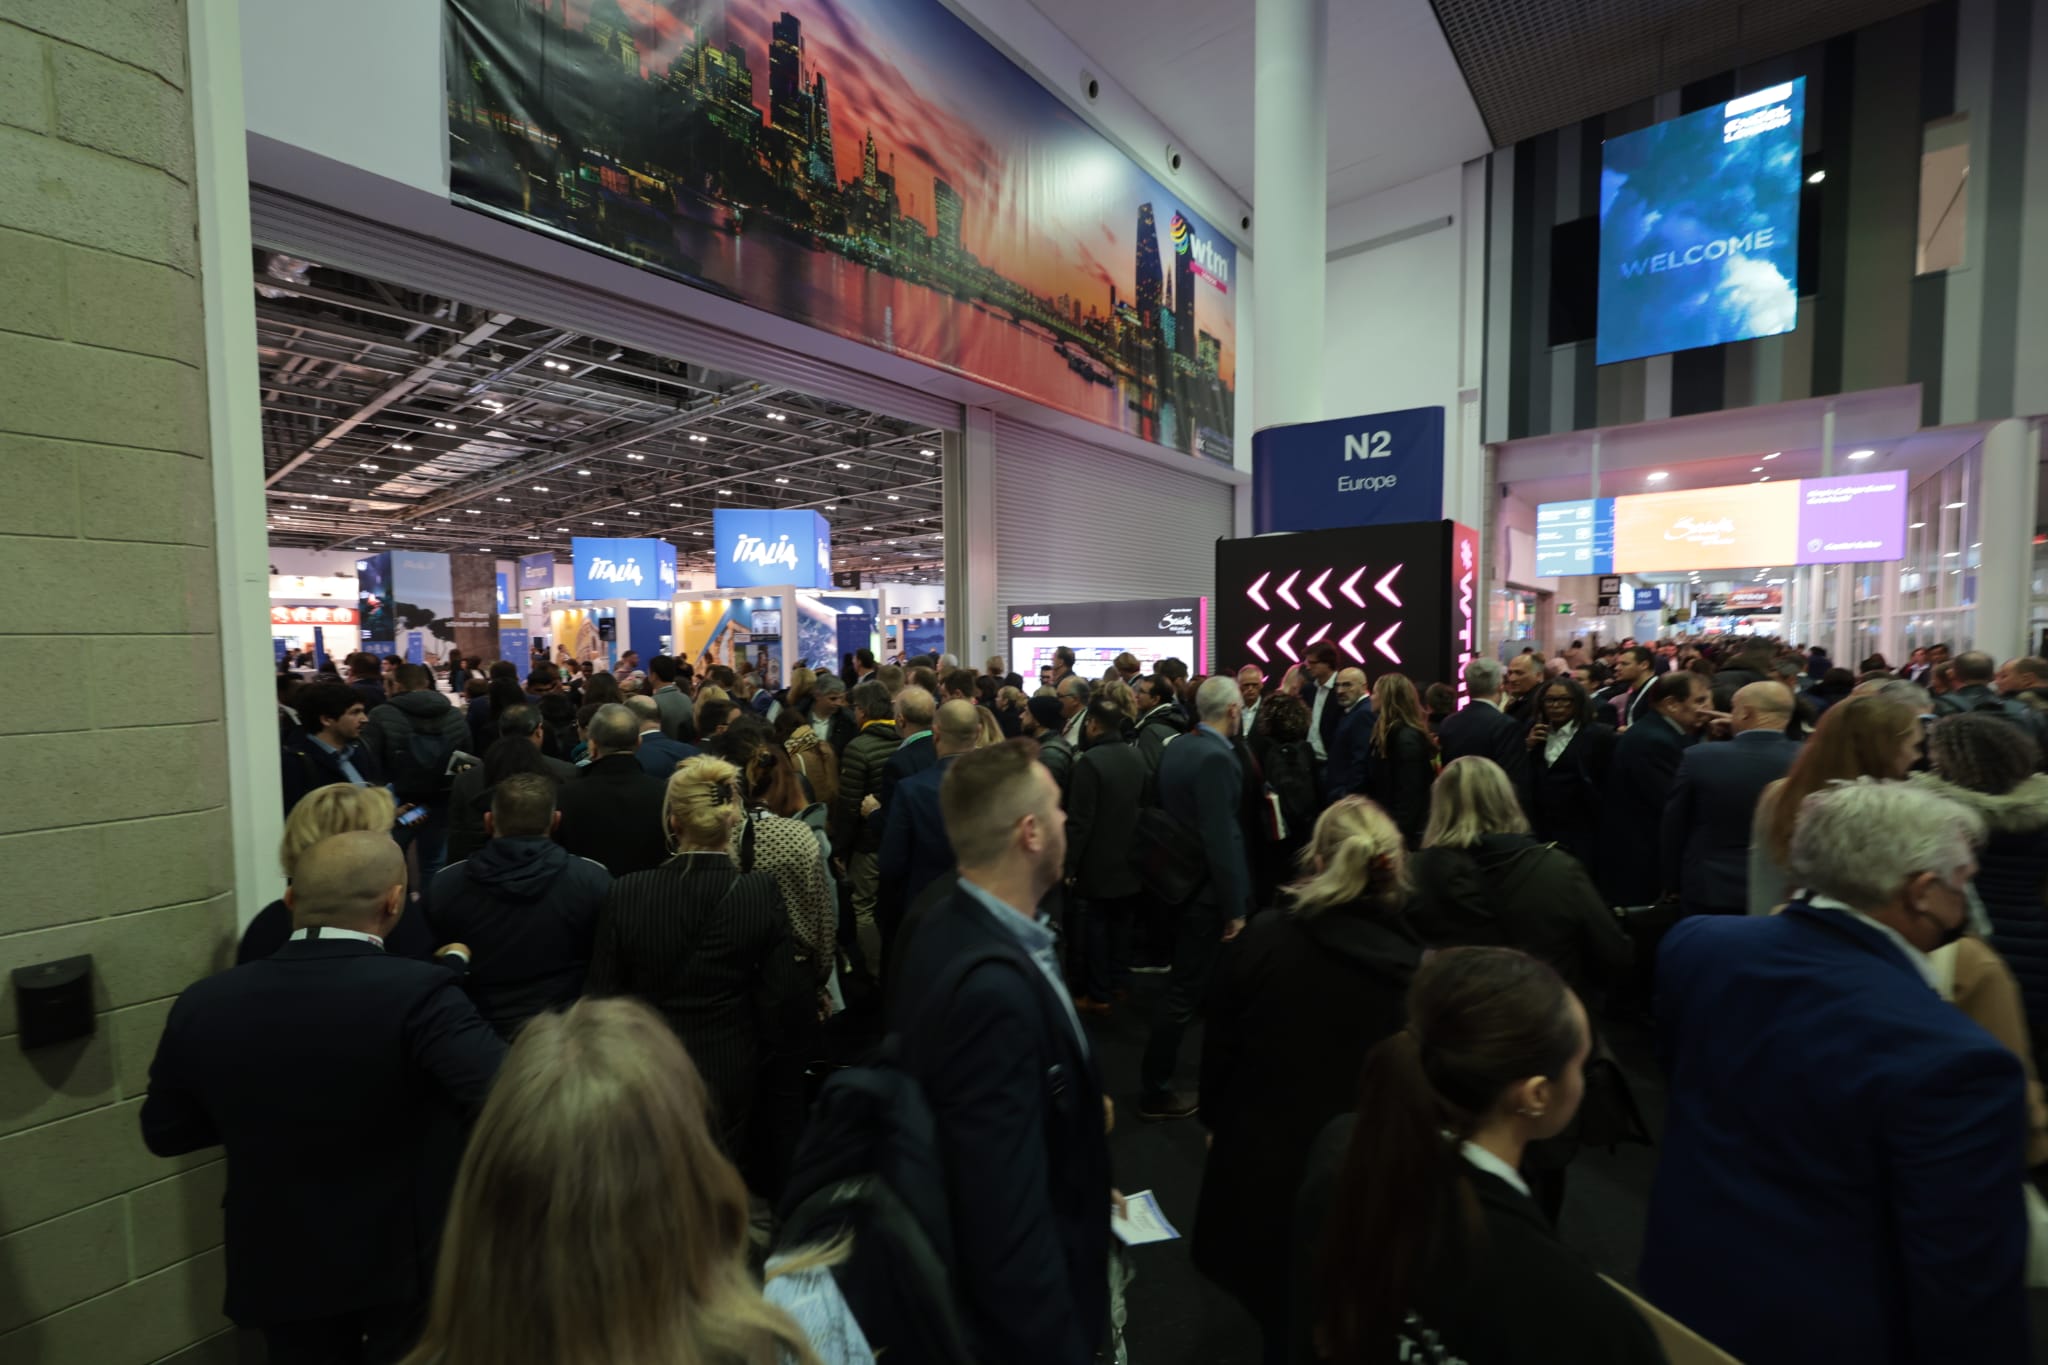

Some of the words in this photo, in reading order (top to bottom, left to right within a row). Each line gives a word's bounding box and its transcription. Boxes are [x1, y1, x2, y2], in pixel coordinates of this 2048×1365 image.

[1189, 233, 1228, 281] wtm
[1620, 226, 1775, 279] WELCOME
[1344, 430, 1392, 461] N2
[1337, 474, 1397, 492] Europe
[1023, 613, 1051, 626] wtm
